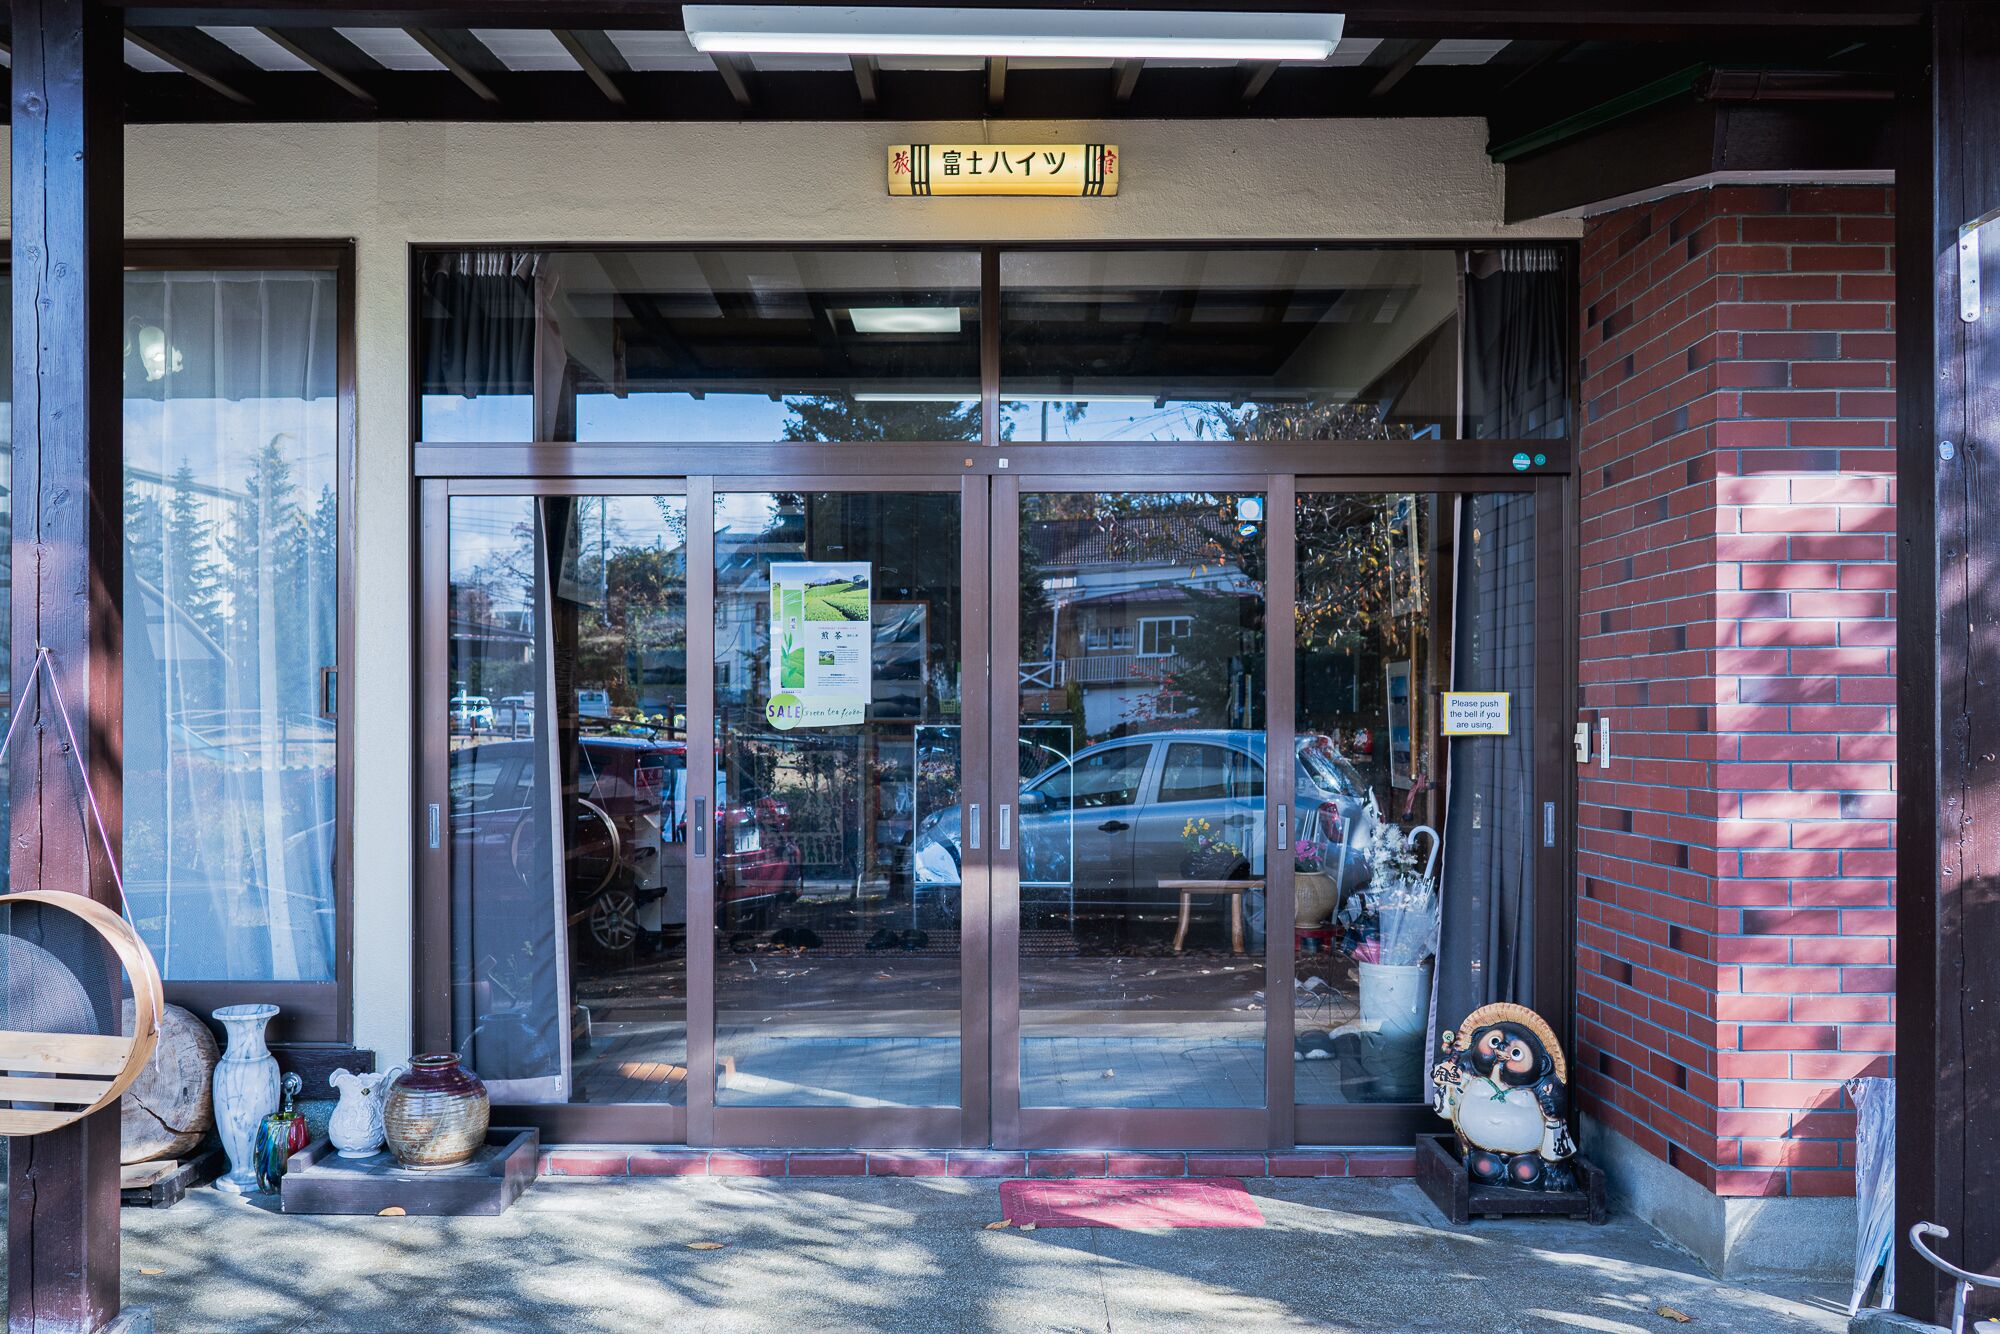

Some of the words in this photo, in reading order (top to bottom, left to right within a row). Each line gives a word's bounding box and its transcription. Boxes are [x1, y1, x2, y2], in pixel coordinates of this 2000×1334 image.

[892, 151, 911, 174] 旅
[942, 150, 1065, 176] 富士ハイツ
[1451, 700, 1478, 708] Please
[1480, 700, 1499, 708] push
[768, 705, 801, 718] SALE
[803, 707, 825, 716] Green
[827, 707, 839, 715] tea
[1464, 710, 1478, 718] bell
[1480, 710, 1484, 718] if
[1486, 711, 1501, 719] you
[1471, 721, 1494, 730] using.
